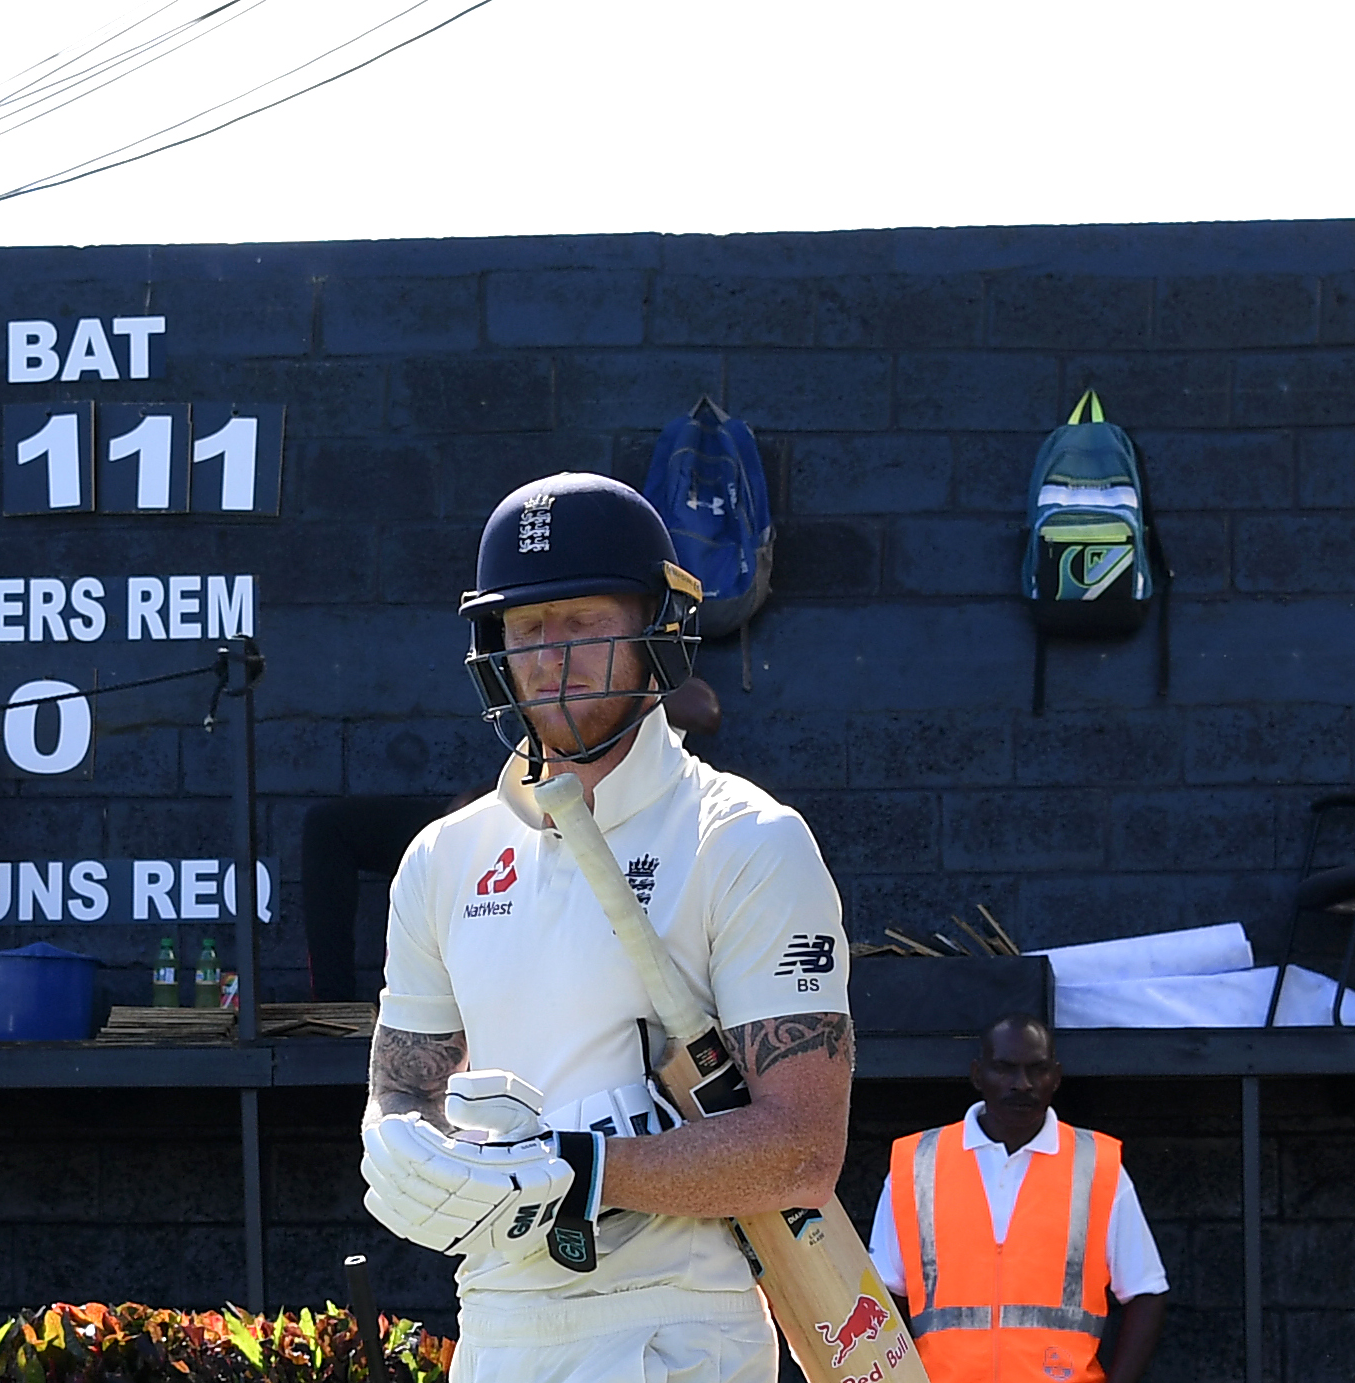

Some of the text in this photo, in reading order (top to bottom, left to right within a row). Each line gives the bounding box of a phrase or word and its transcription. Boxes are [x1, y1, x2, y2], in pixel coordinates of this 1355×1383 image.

[7, 316, 166, 384] BAT
[17, 413, 258, 511] 111
[127, 575, 255, 640] REM
[133, 859, 272, 924] REQ
[463, 899, 512, 918] NatWest
[797, 977, 820, 993] BS
[886, 1332, 909, 1369] Bull
